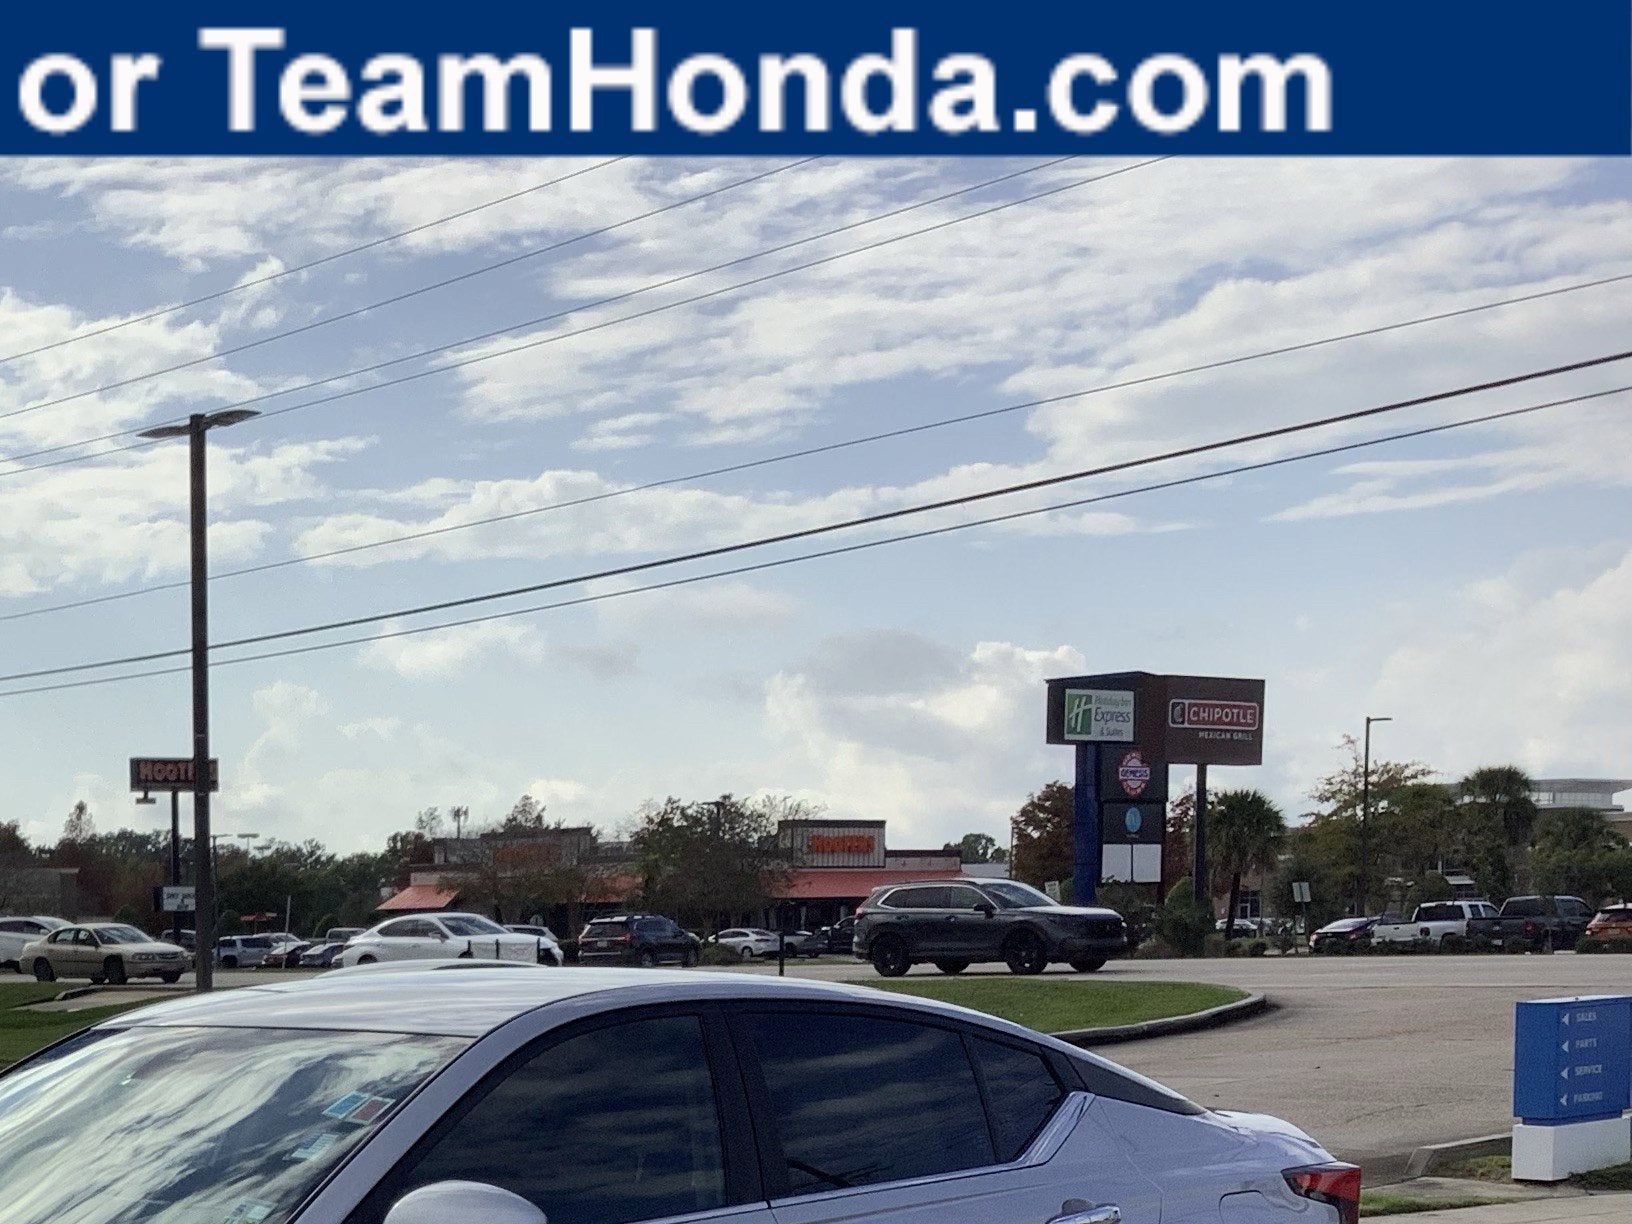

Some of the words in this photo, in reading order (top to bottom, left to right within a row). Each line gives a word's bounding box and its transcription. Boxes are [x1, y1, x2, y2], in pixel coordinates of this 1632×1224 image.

[1094, 706, 1131, 725] Express
[1189, 707, 1255, 723] CHIPOTLE
[1199, 731, 1231, 739] MEXICAN
[1232, 732, 1254, 740] GRILL
